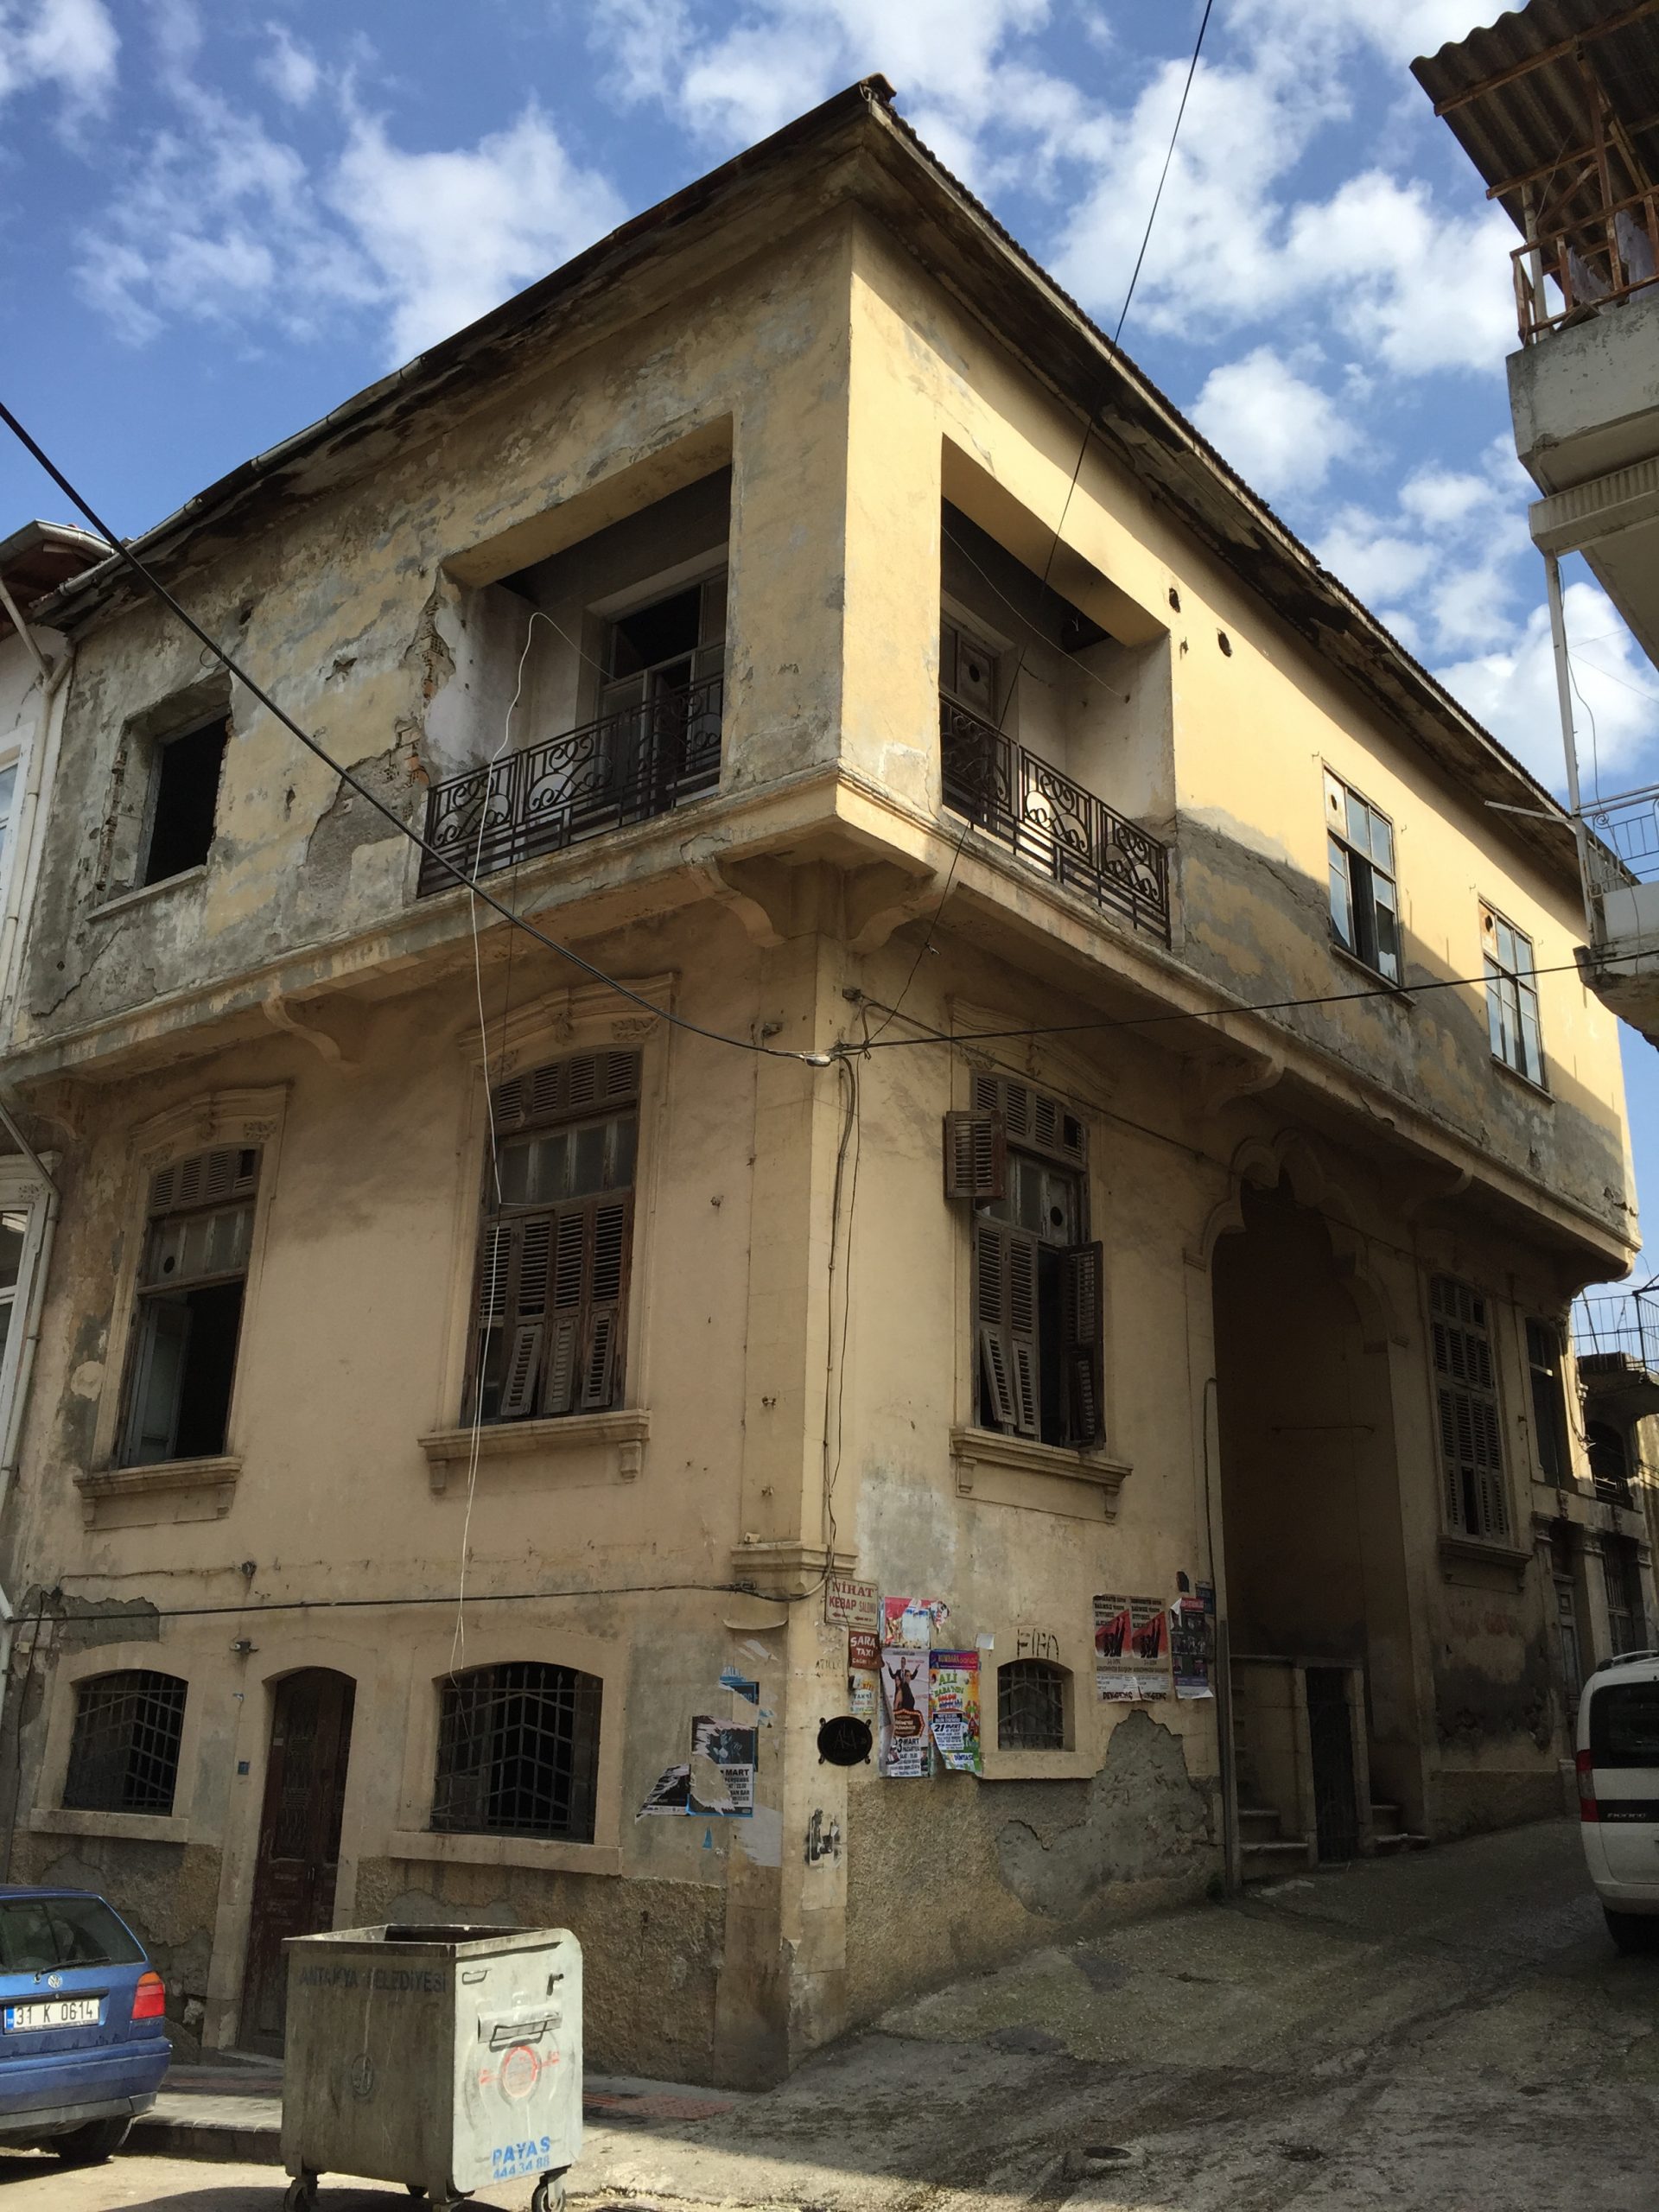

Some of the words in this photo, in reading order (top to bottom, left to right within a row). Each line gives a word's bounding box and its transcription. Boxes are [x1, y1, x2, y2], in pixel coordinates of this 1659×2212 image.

[832, 1581, 874, 1598] NİHAT
[830, 1596, 856, 1610] KEBAP
[850, 1636, 878, 1649] SARA
[856, 1648, 874, 1656] TAXI
[16, 2005, 32, 2025] 31
[44, 2004, 51, 2023] K
[61, 2001, 92, 2021] 0614
[493, 2136, 550, 2166] PAYAS
[493, 2164, 516, 2179] 444
[519, 2160, 532, 2174] 34
